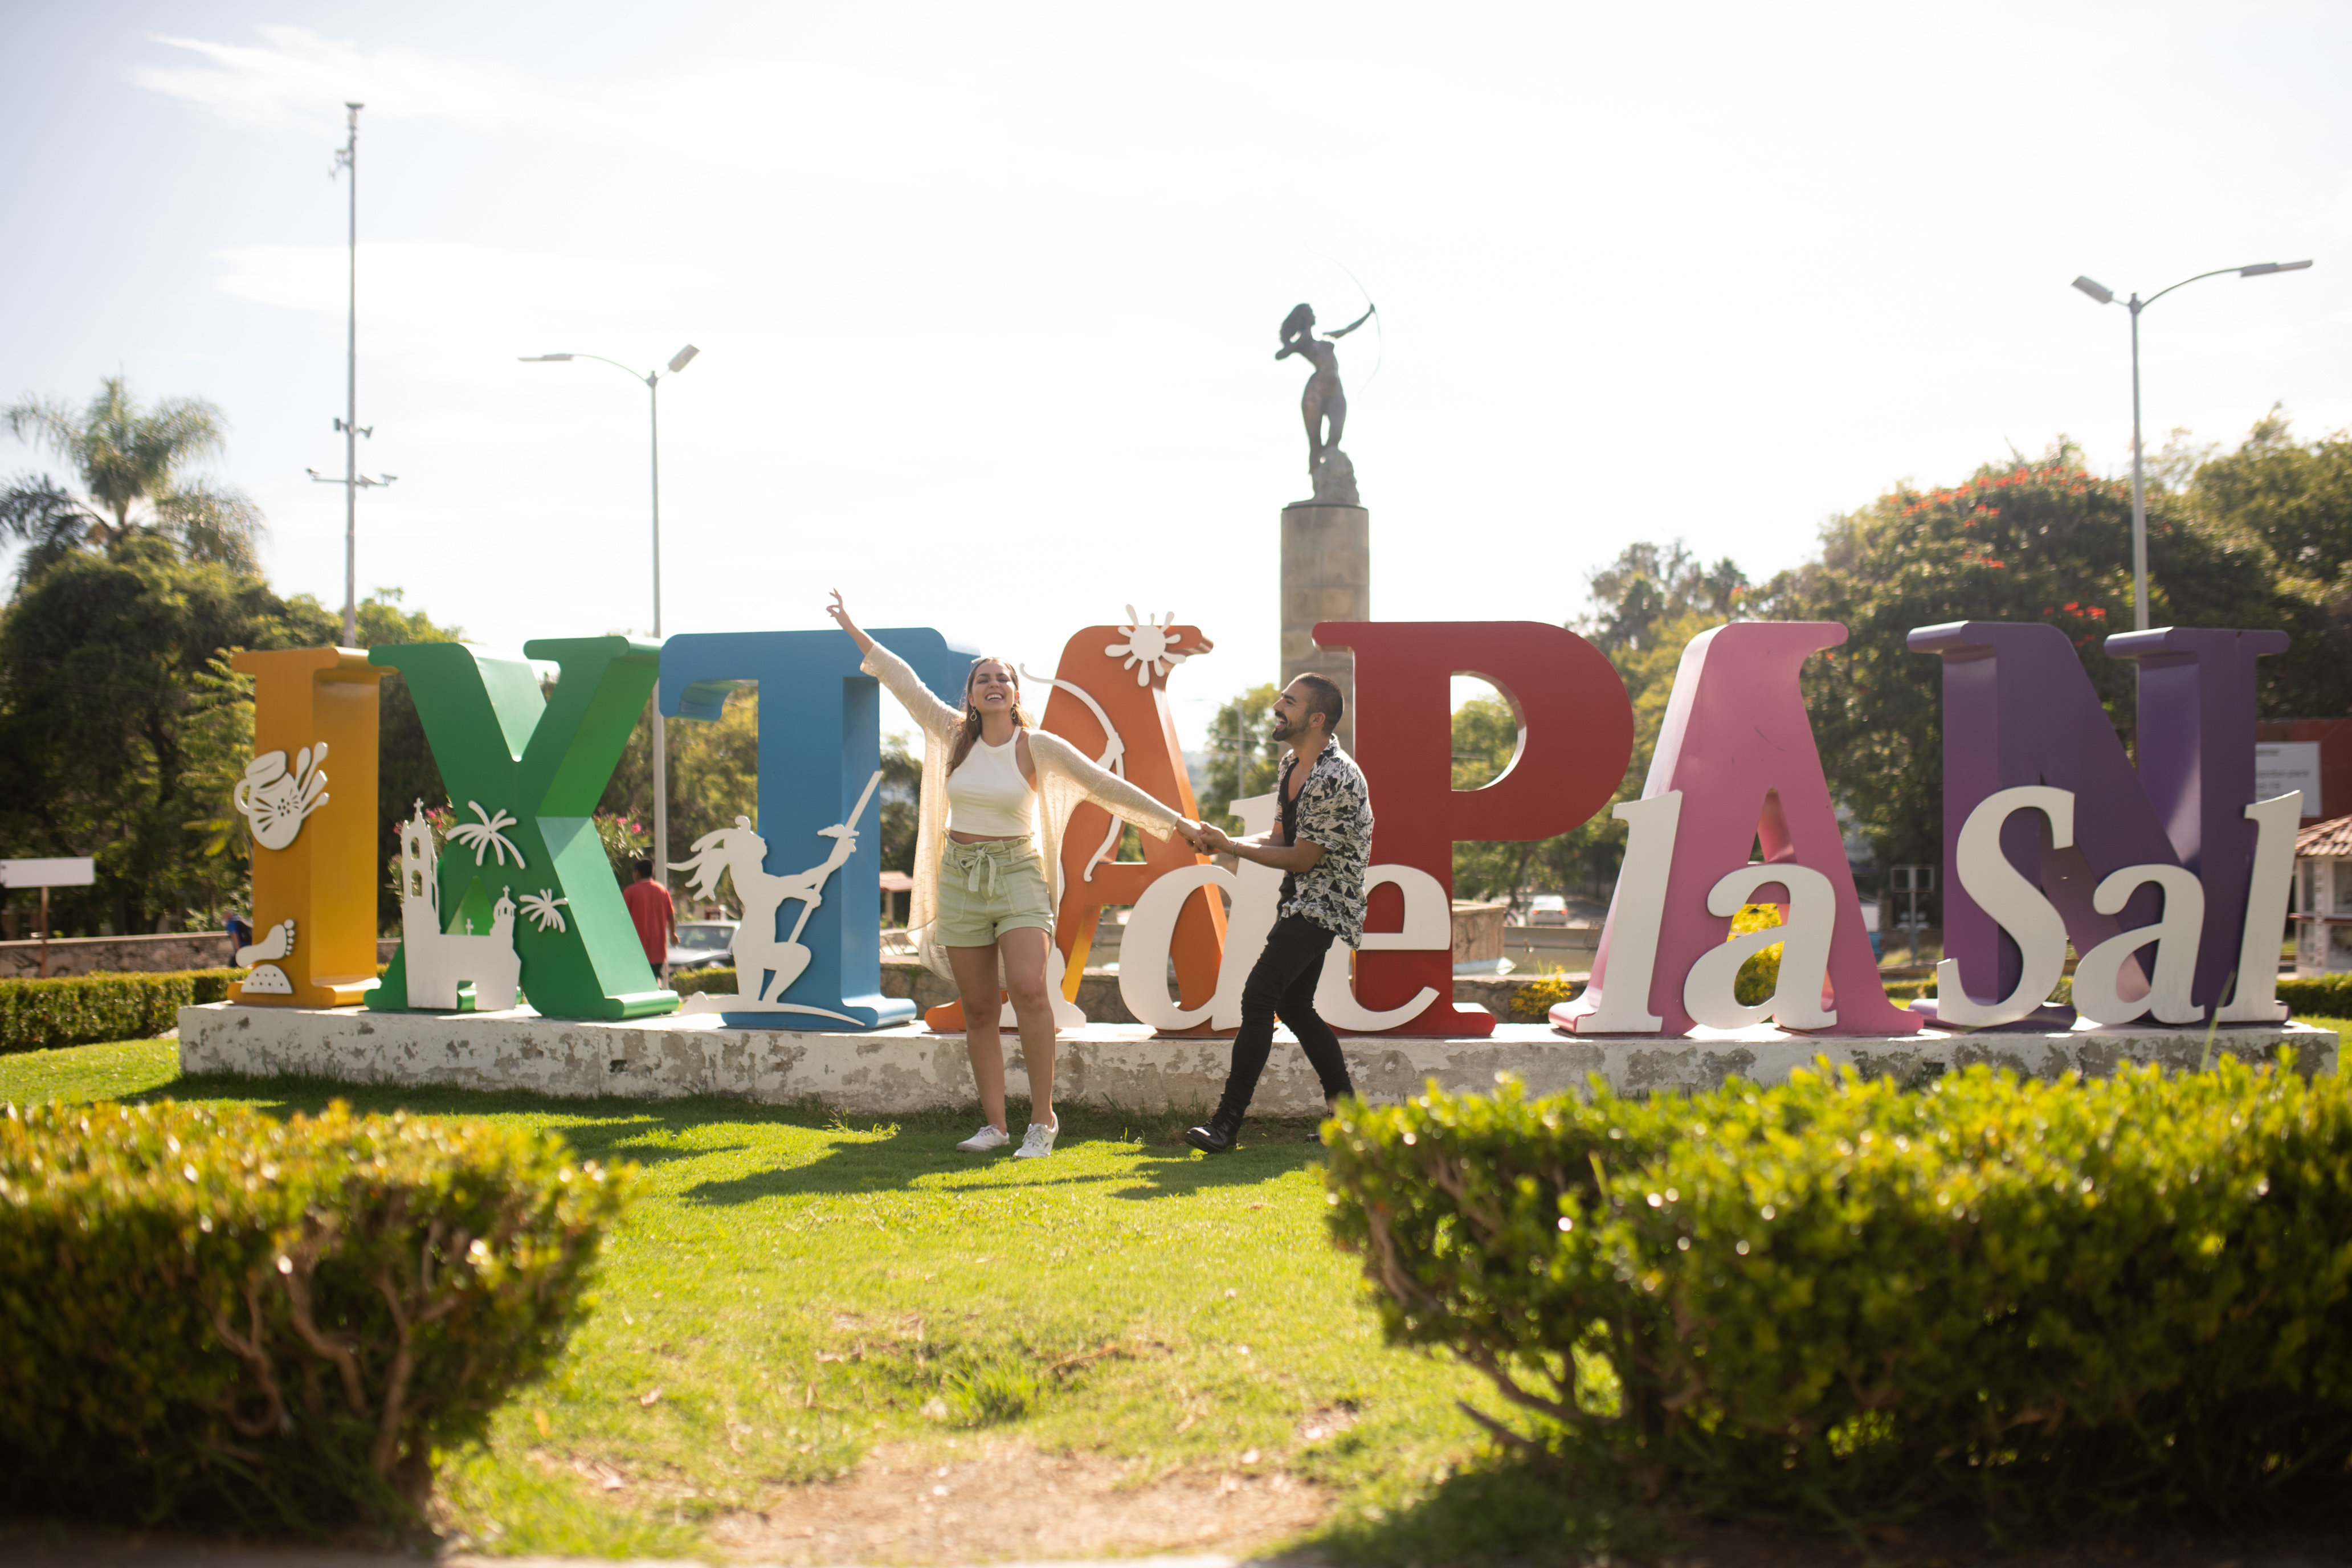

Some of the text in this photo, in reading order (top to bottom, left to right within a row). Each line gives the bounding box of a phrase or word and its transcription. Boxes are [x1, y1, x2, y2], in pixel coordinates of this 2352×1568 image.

[228, 622, 2290, 1038] IXTAPAN
[1119, 790, 1451, 1031] de
[1612, 789, 1838, 1032] la
[1937, 785, 2303, 1027] Sal
